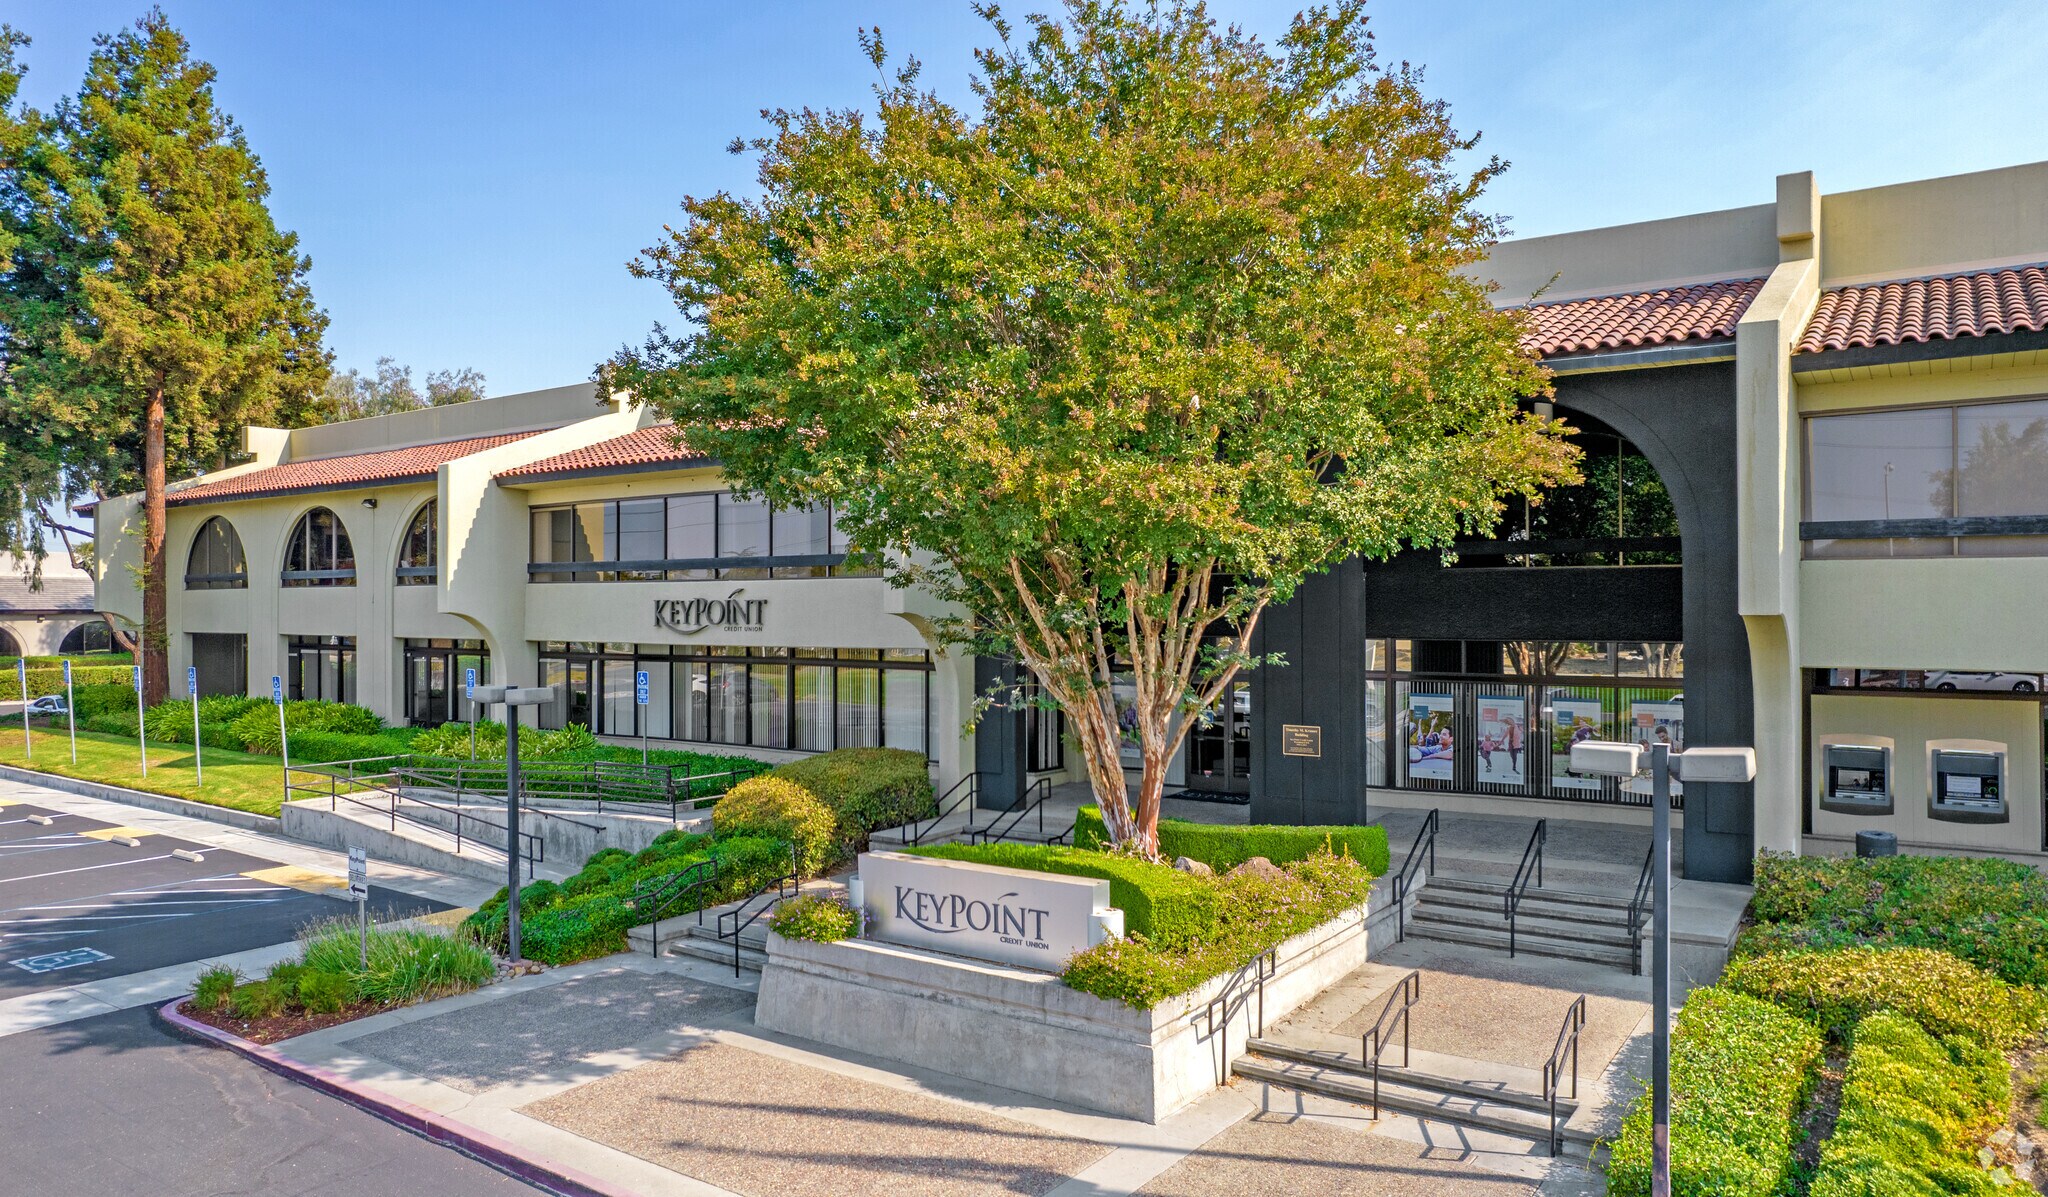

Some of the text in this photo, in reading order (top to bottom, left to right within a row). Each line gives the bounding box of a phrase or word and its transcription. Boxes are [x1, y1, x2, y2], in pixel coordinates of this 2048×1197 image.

[654, 588, 768, 635] KEYPOINT
[894, 885, 1049, 941] KEYPOINT
[1000, 936, 1049, 951] CREDIT UNION
